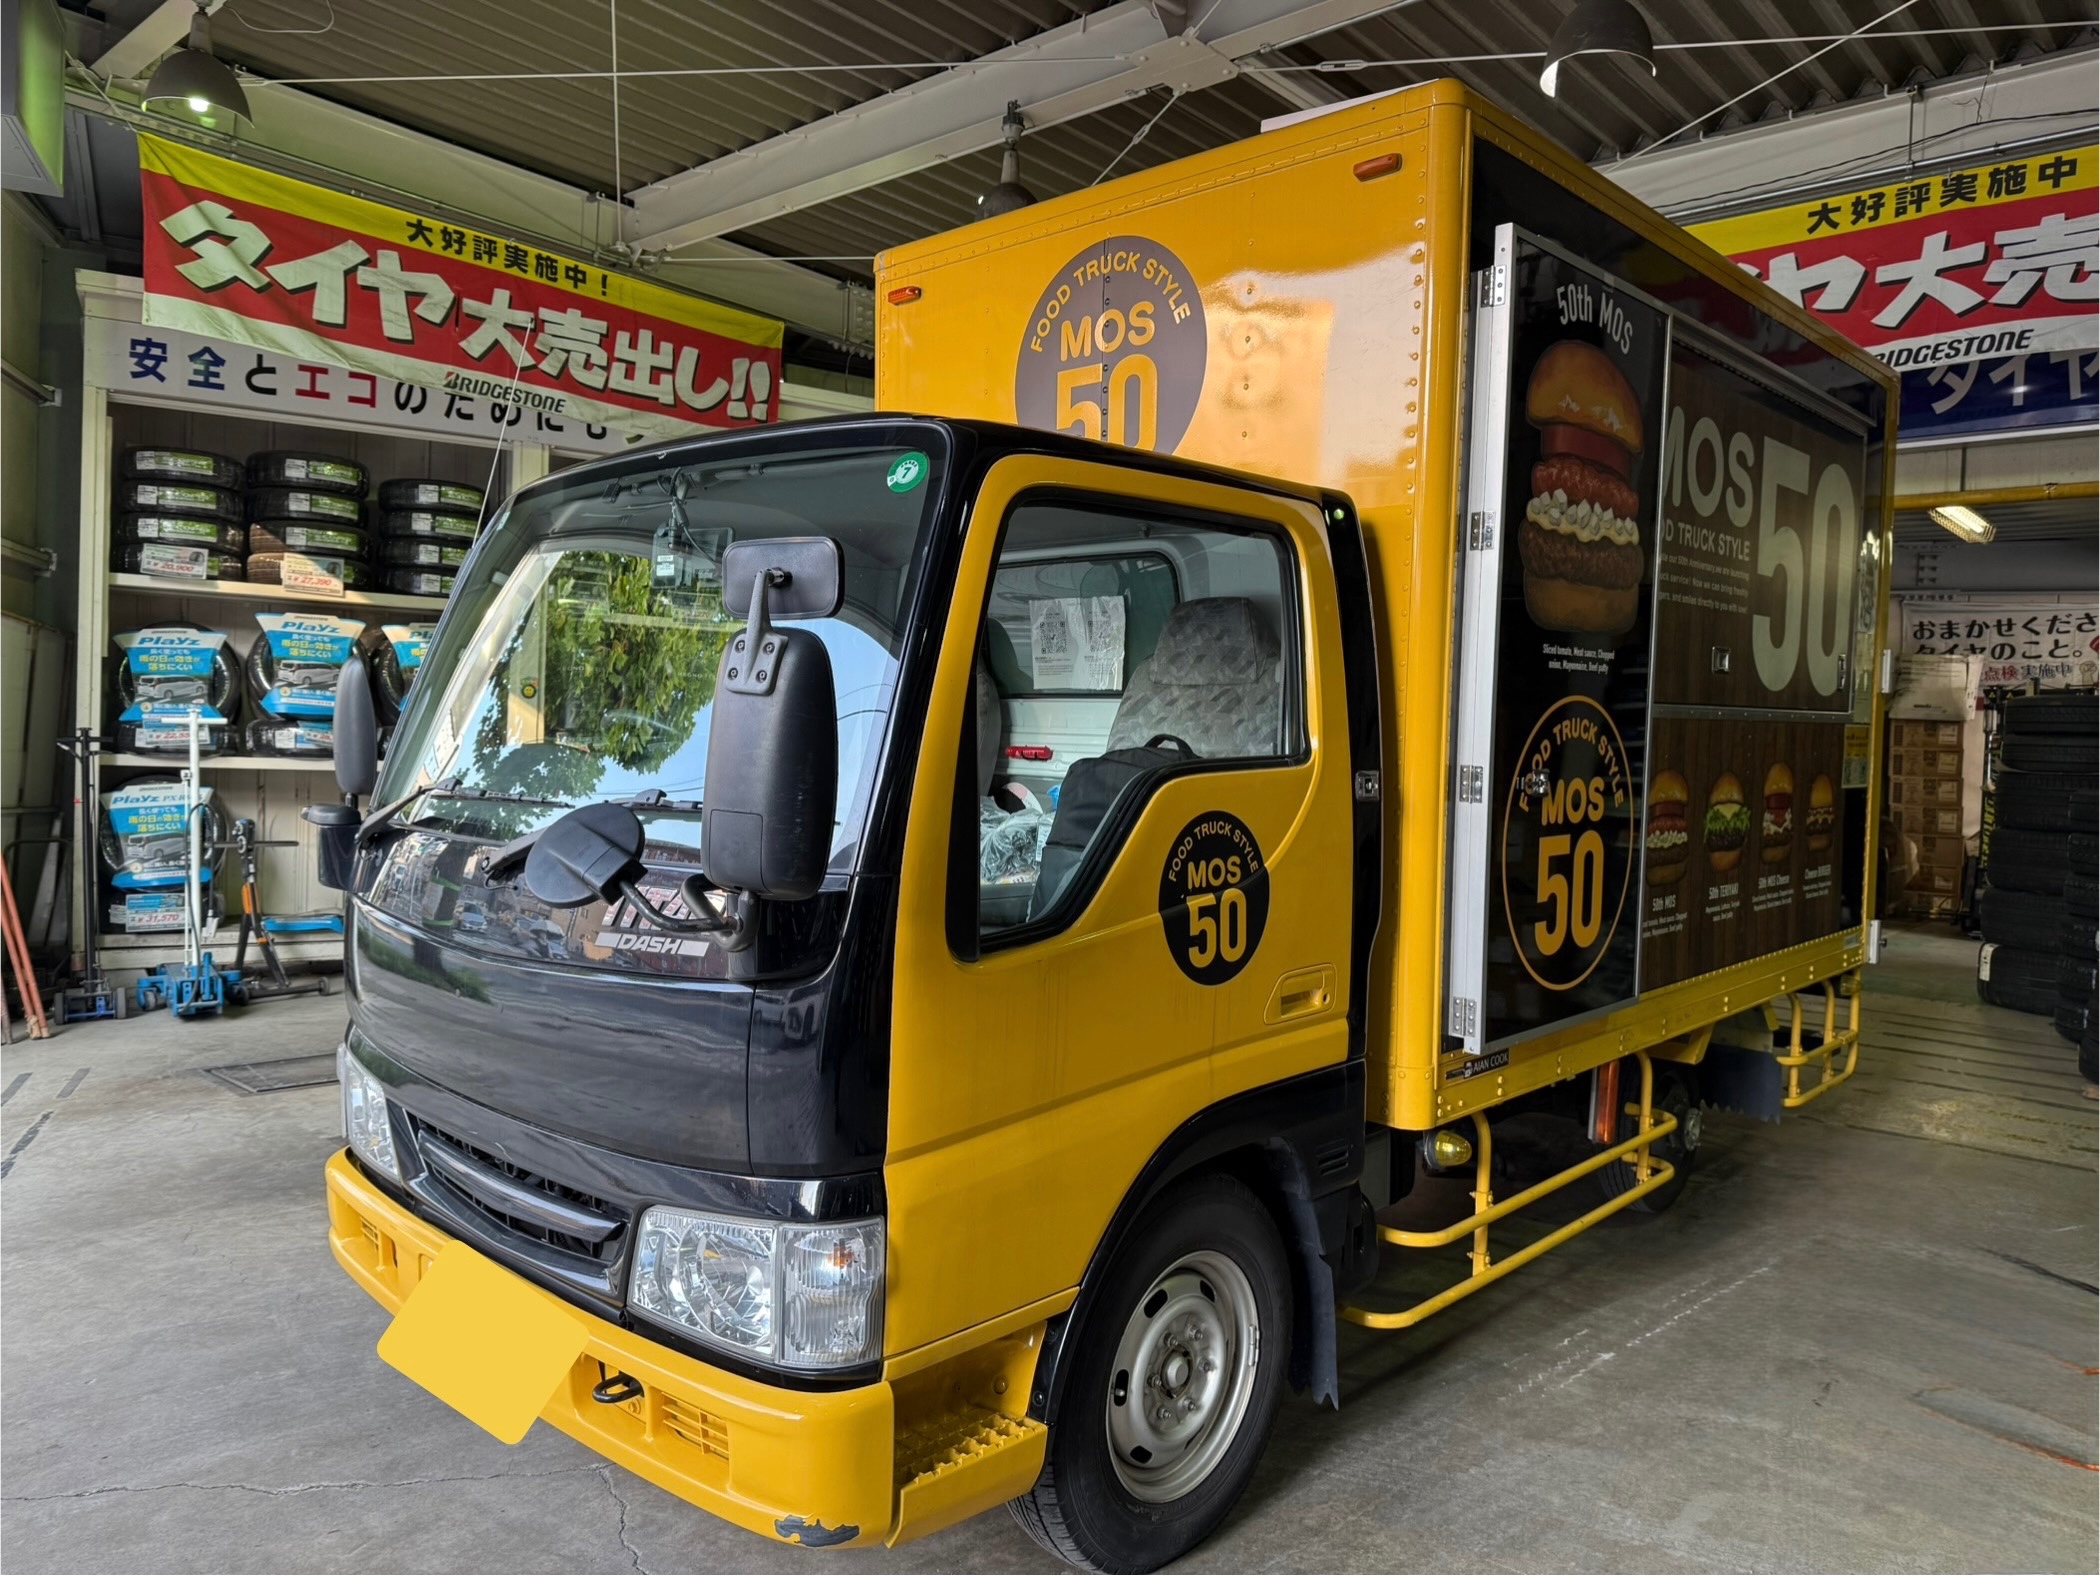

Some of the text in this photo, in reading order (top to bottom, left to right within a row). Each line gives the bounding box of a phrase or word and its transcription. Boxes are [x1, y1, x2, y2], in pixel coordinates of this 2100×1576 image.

[1807, 154, 2078, 234] 大好評実施中
[1735, 212, 2099, 328] ヤ大売
[159, 199, 773, 422] タイヤ大売出し!!
[1030, 251, 1191, 353] FOOD TRUCK STYLE
[1556, 283, 1633, 355] 50th MOS
[1060, 301, 1156, 362] MOS
[443, 371, 566, 414] BRIDGESTONE
[1056, 353, 1158, 451] 50
[902, 467, 912, 479] 7
[1677, 522, 1716, 553] TRUCK
[1718, 533, 1751, 562] STYLE
[1752, 435, 1855, 697] 50
[138, 636, 202, 646] Playz
[281, 621, 341, 633] Playz
[1913, 612, 2098, 641] おまかせくださ
[1981, 661, 2073, 682] 点検実施中
[1553, 717, 1598, 746] TRUCK
[1598, 735, 1624, 808] STYLE
[112, 795, 160, 804] Playz
[1541, 776, 1605, 826] MOS
[1168, 820, 1259, 882] FOOD TRUCK STYLE
[1187, 855, 1242, 890] MOS
[1535, 830, 1605, 956] 50
[1664, 894, 1676, 910] MOS
[617, 933, 682, 956] DASH
[1186, 887, 1247, 969] 50
[1490, 1052, 1509, 1068] COOK
